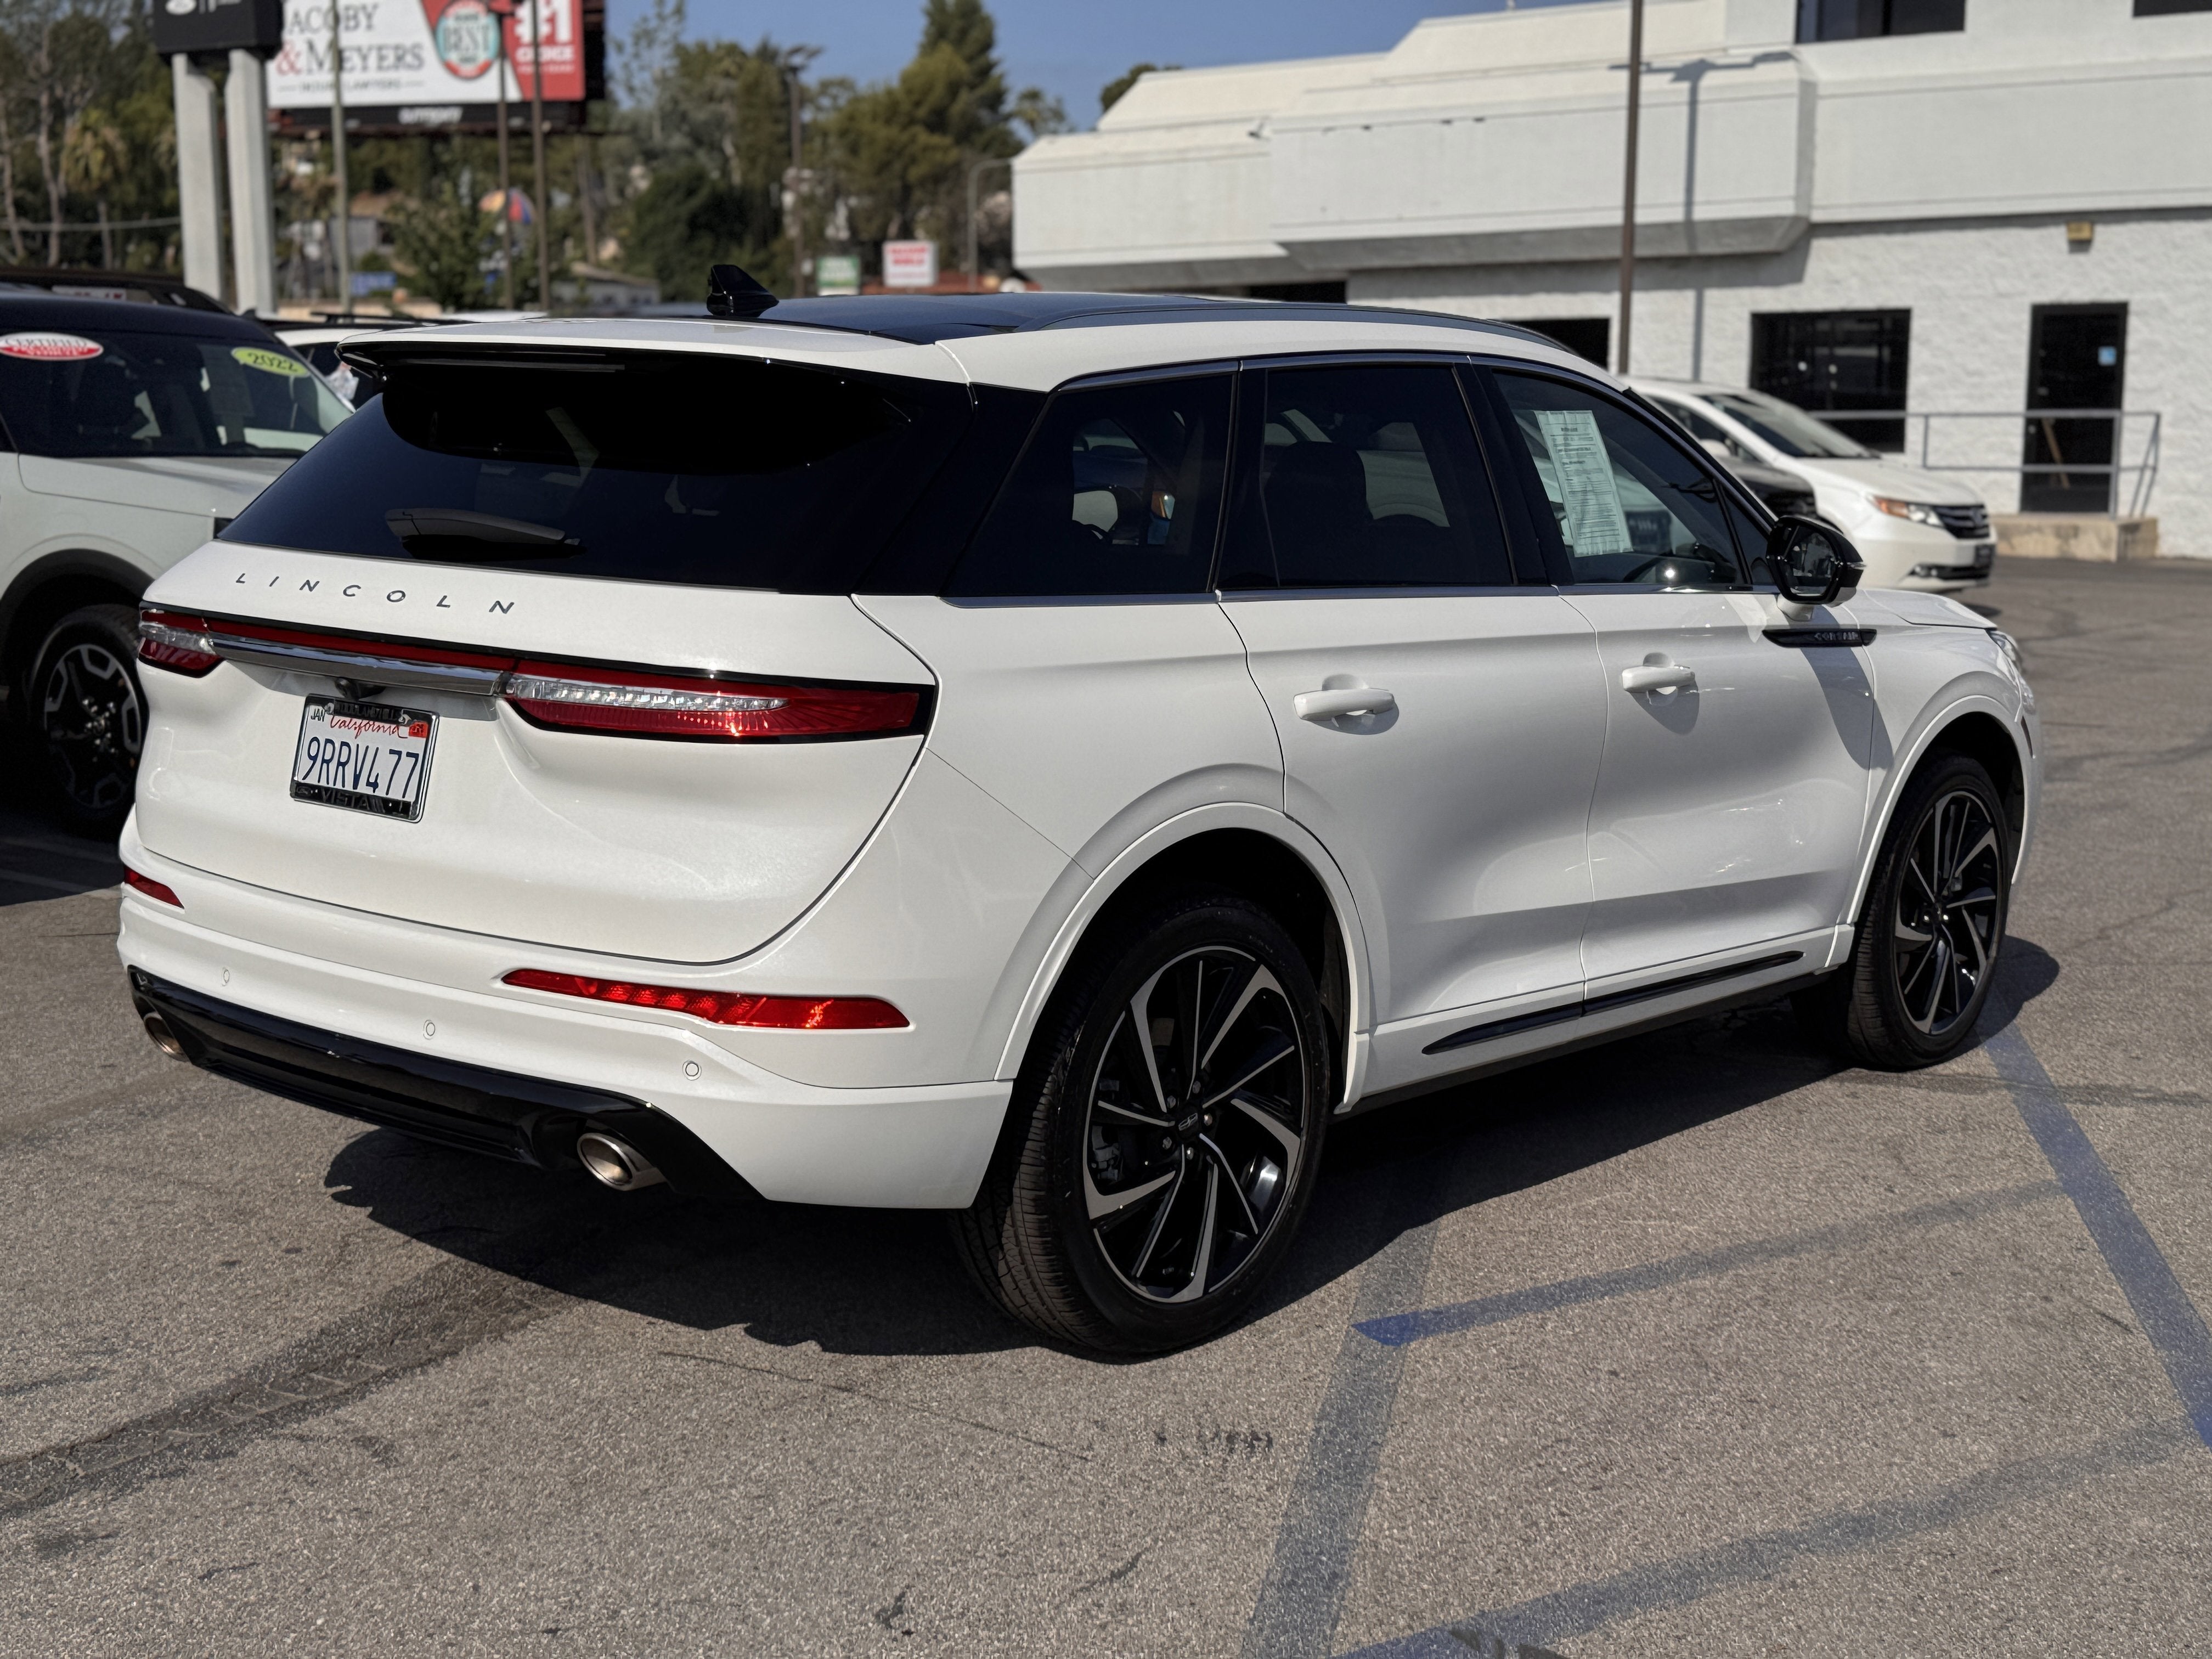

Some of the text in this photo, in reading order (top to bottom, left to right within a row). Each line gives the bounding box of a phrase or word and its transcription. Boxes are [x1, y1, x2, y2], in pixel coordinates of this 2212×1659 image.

[286, 3, 380, 35] ACOBY
[305, 38, 425, 75] MEYERS
[247, 352, 298, 373] 2022
[236, 573, 515, 614] LINCOLN
[330, 715, 408, 739] California
[302, 736, 419, 799] 9RRV477
[321, 787, 370, 811] VISTA
